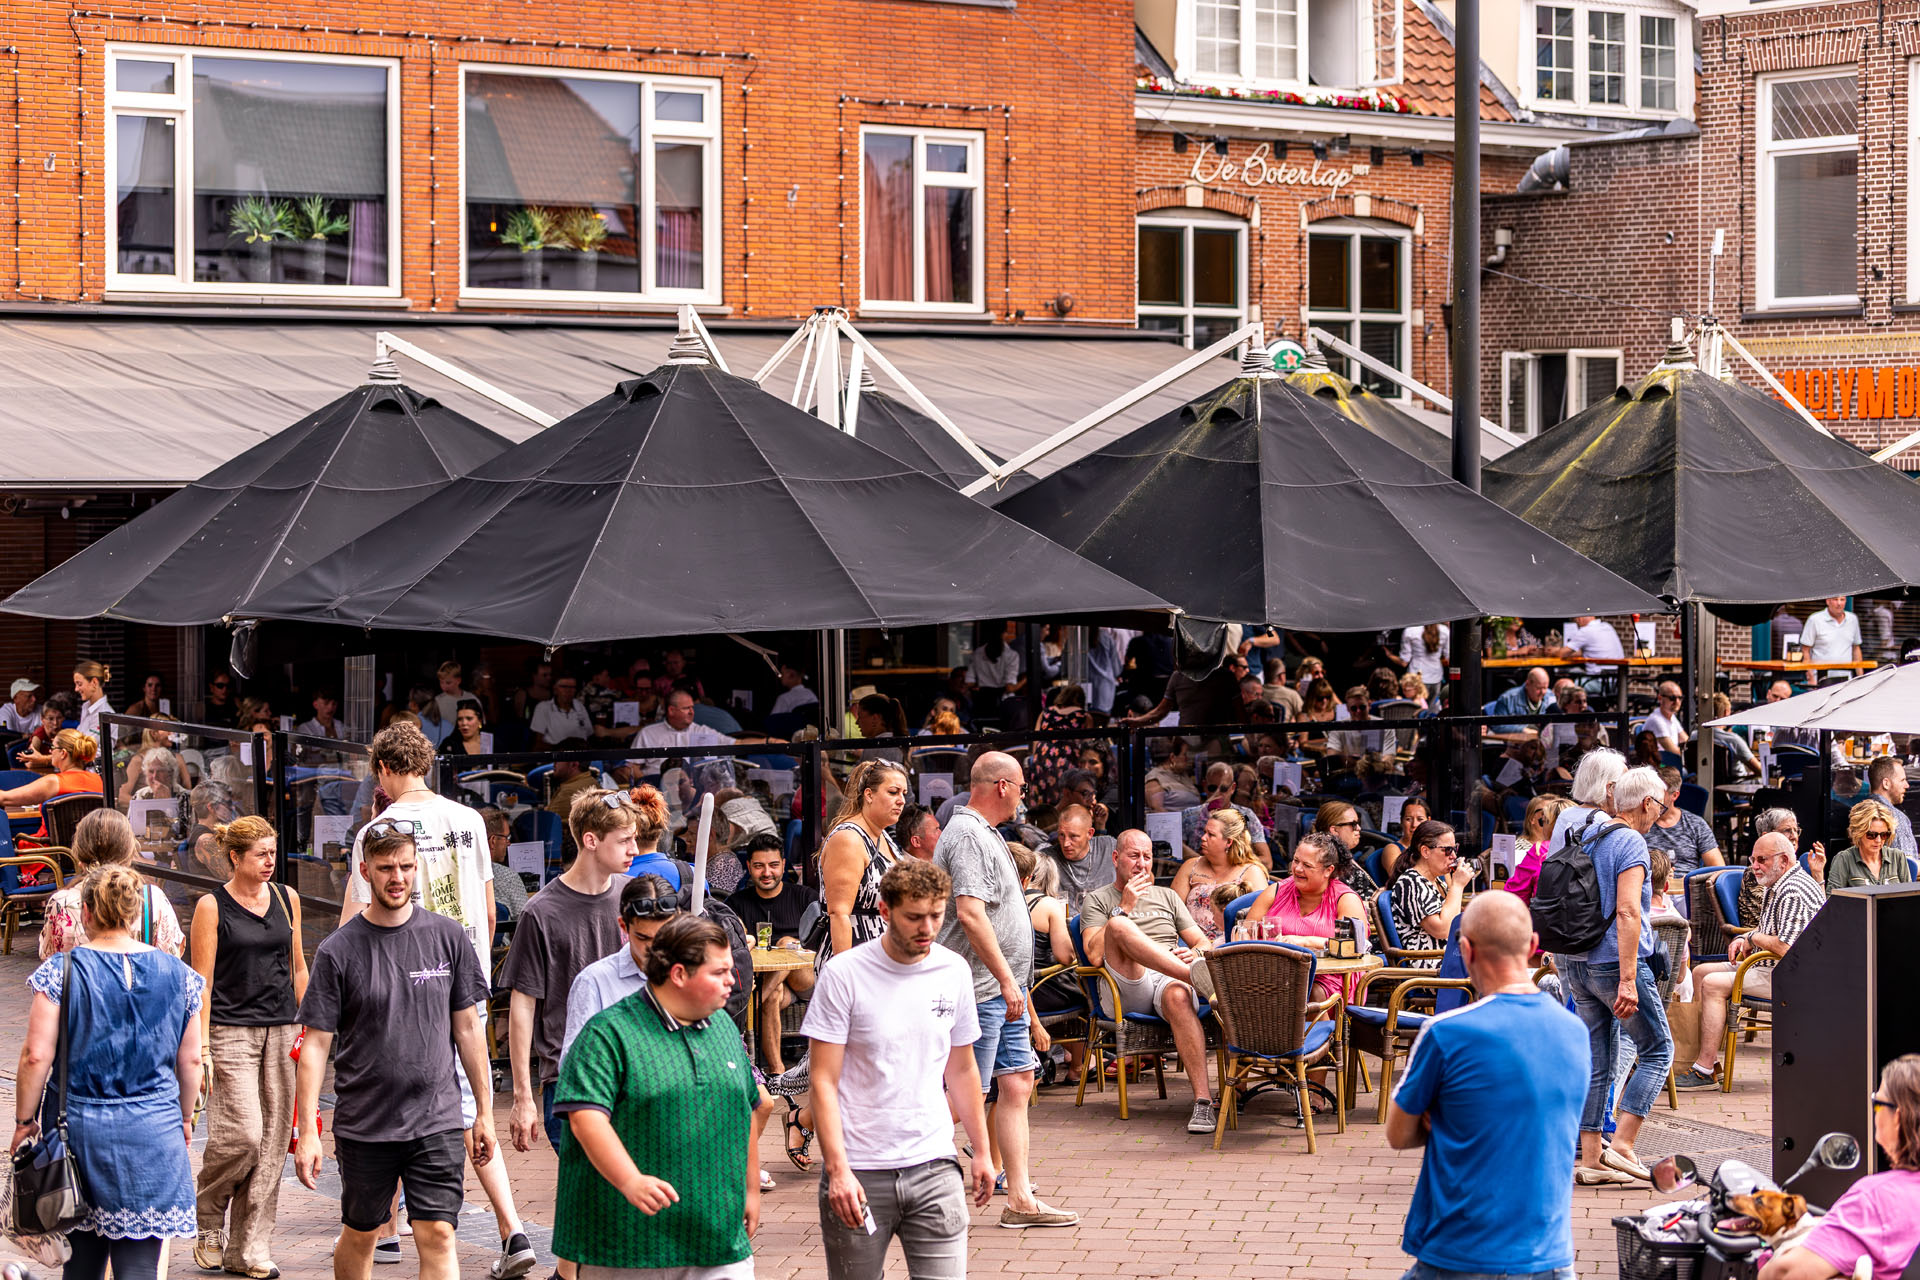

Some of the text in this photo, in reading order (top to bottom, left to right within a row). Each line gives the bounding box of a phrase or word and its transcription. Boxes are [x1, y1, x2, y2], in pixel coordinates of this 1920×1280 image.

[1191, 142, 1237, 183] De
[1241, 143, 1354, 201] Boterlap
[1784, 366, 1920, 419] HOLYMO
